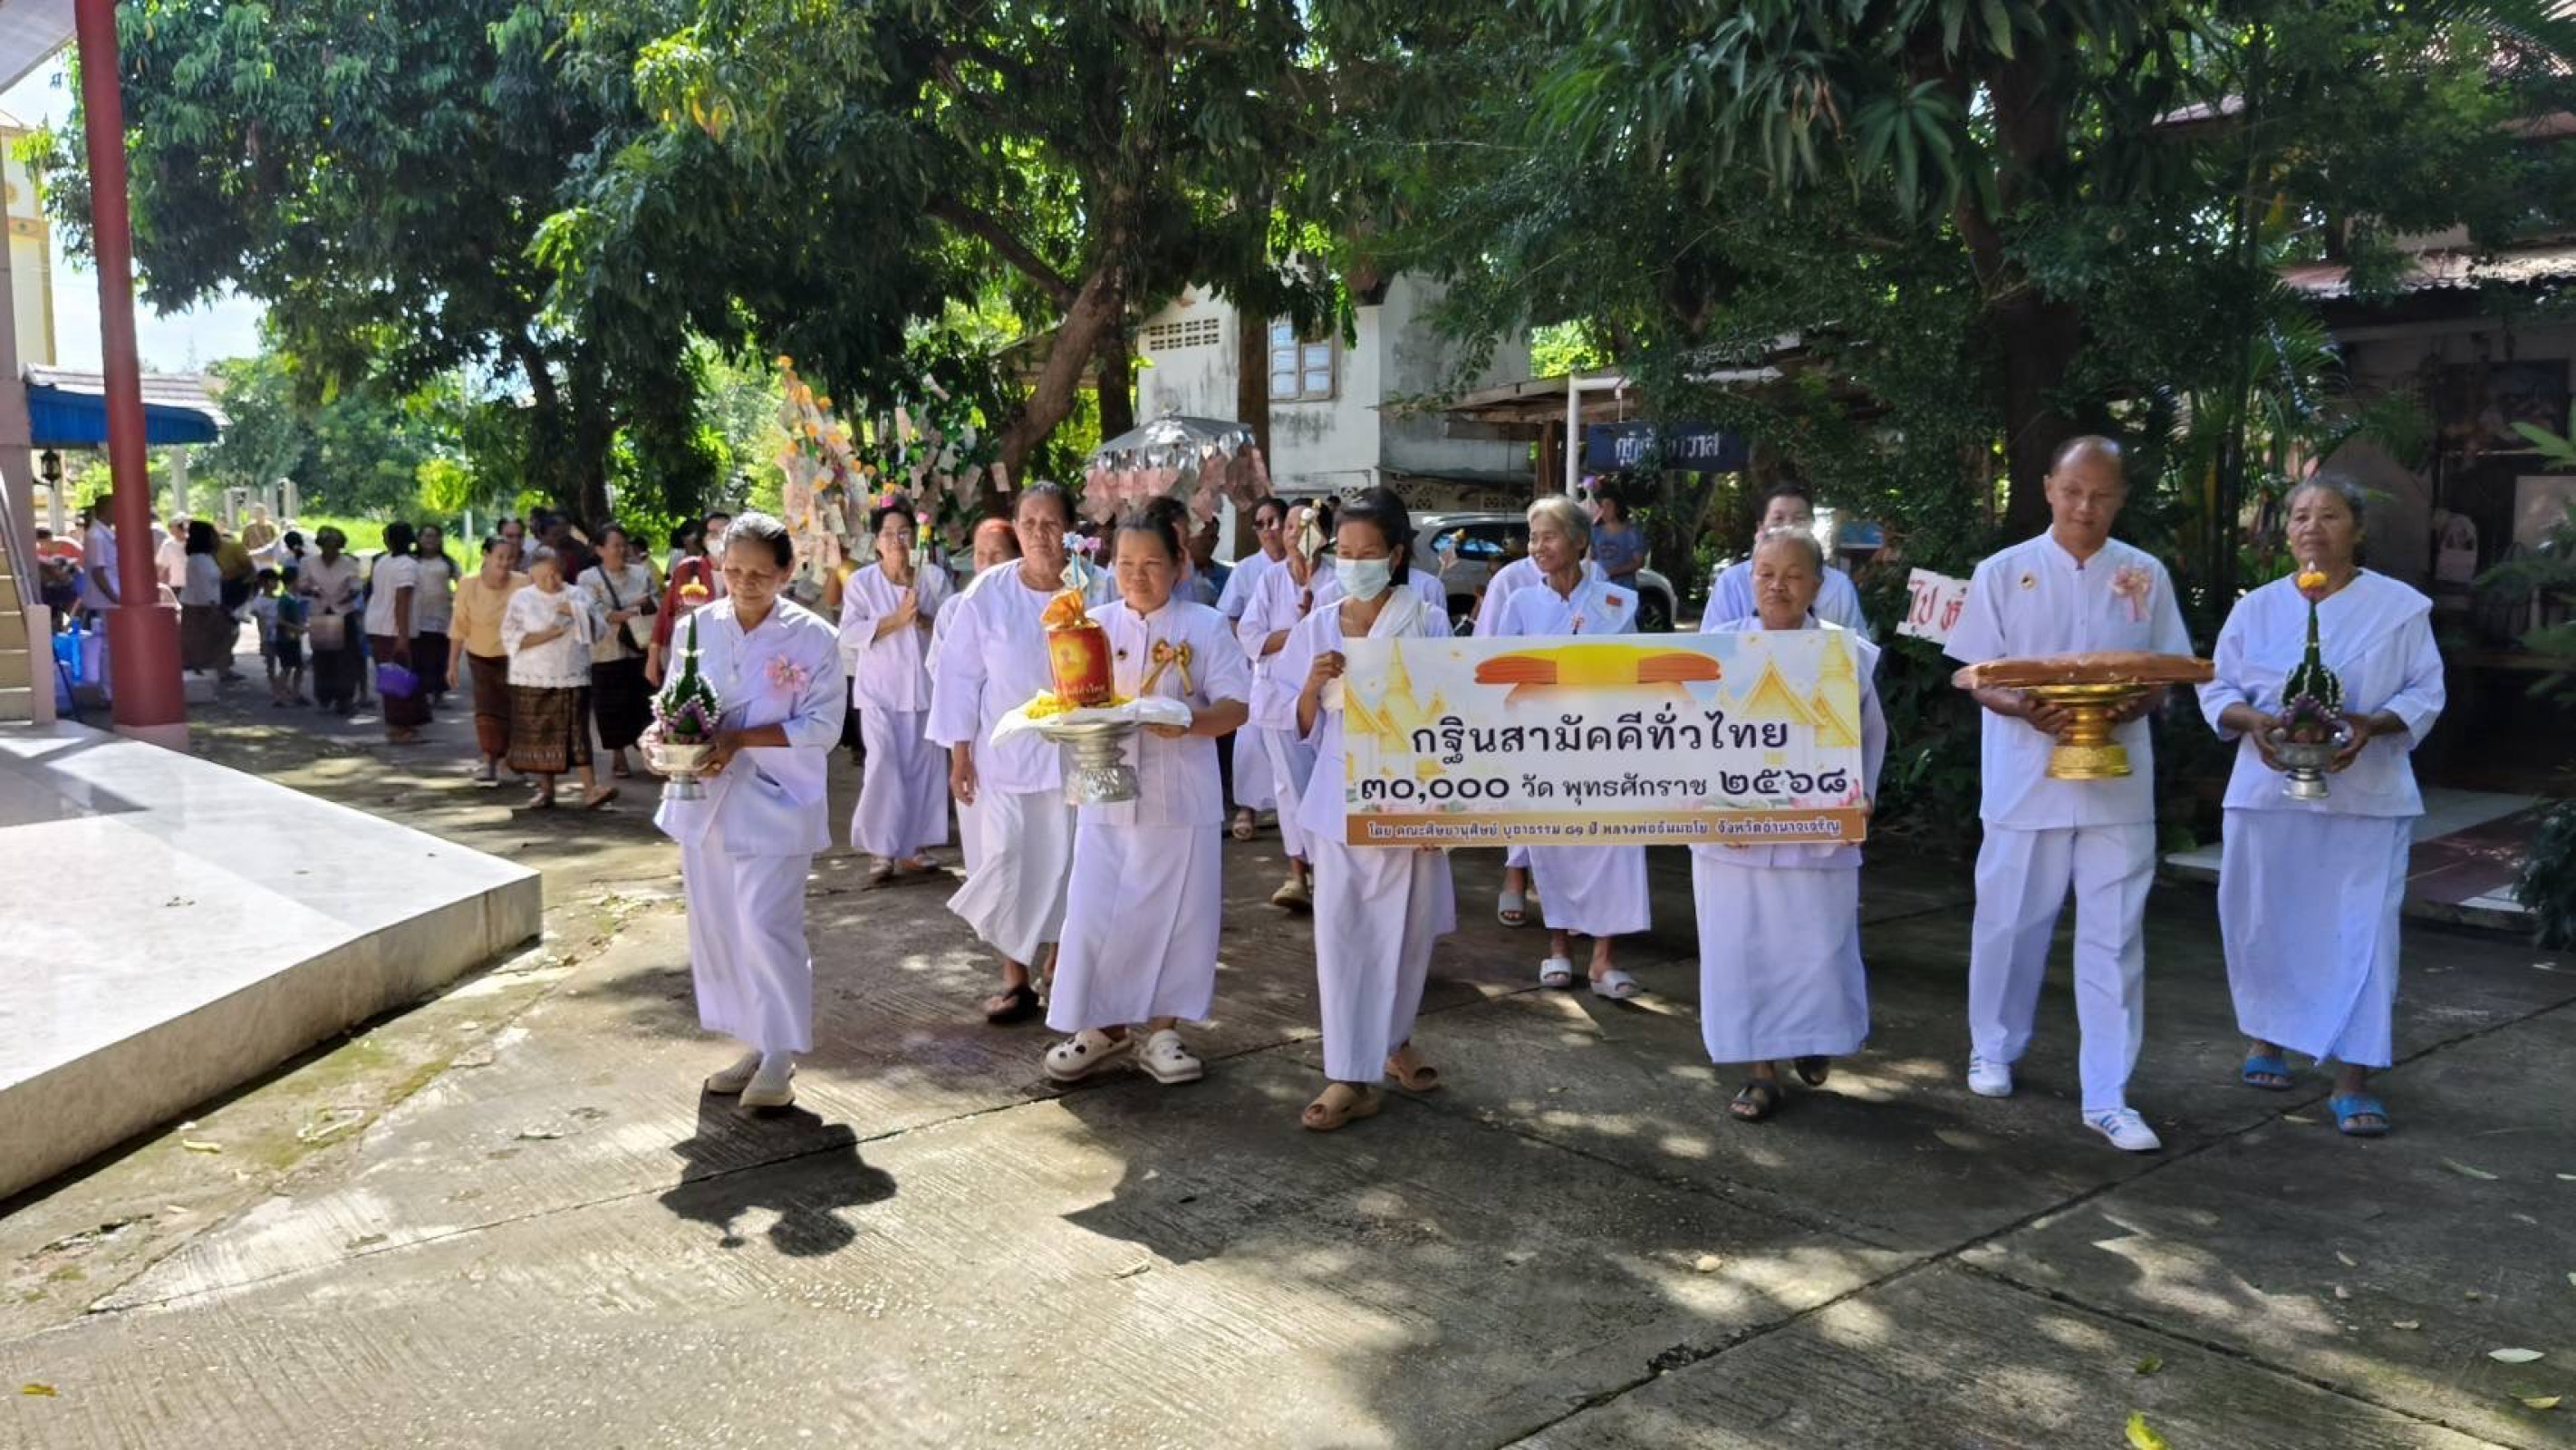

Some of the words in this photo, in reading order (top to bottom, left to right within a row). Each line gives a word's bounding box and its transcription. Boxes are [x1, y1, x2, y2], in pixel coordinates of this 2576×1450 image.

[1412, 701, 1789, 764] กฐินสามัคคีทั่วไทย
[1361, 778, 1510, 805] ๓๐,๐๐๐
[1521, 773, 1554, 798] วัด
[1562, 772, 1707, 806] พุทธศักราช
[1720, 768, 1848, 795] ๒๕๖๘
